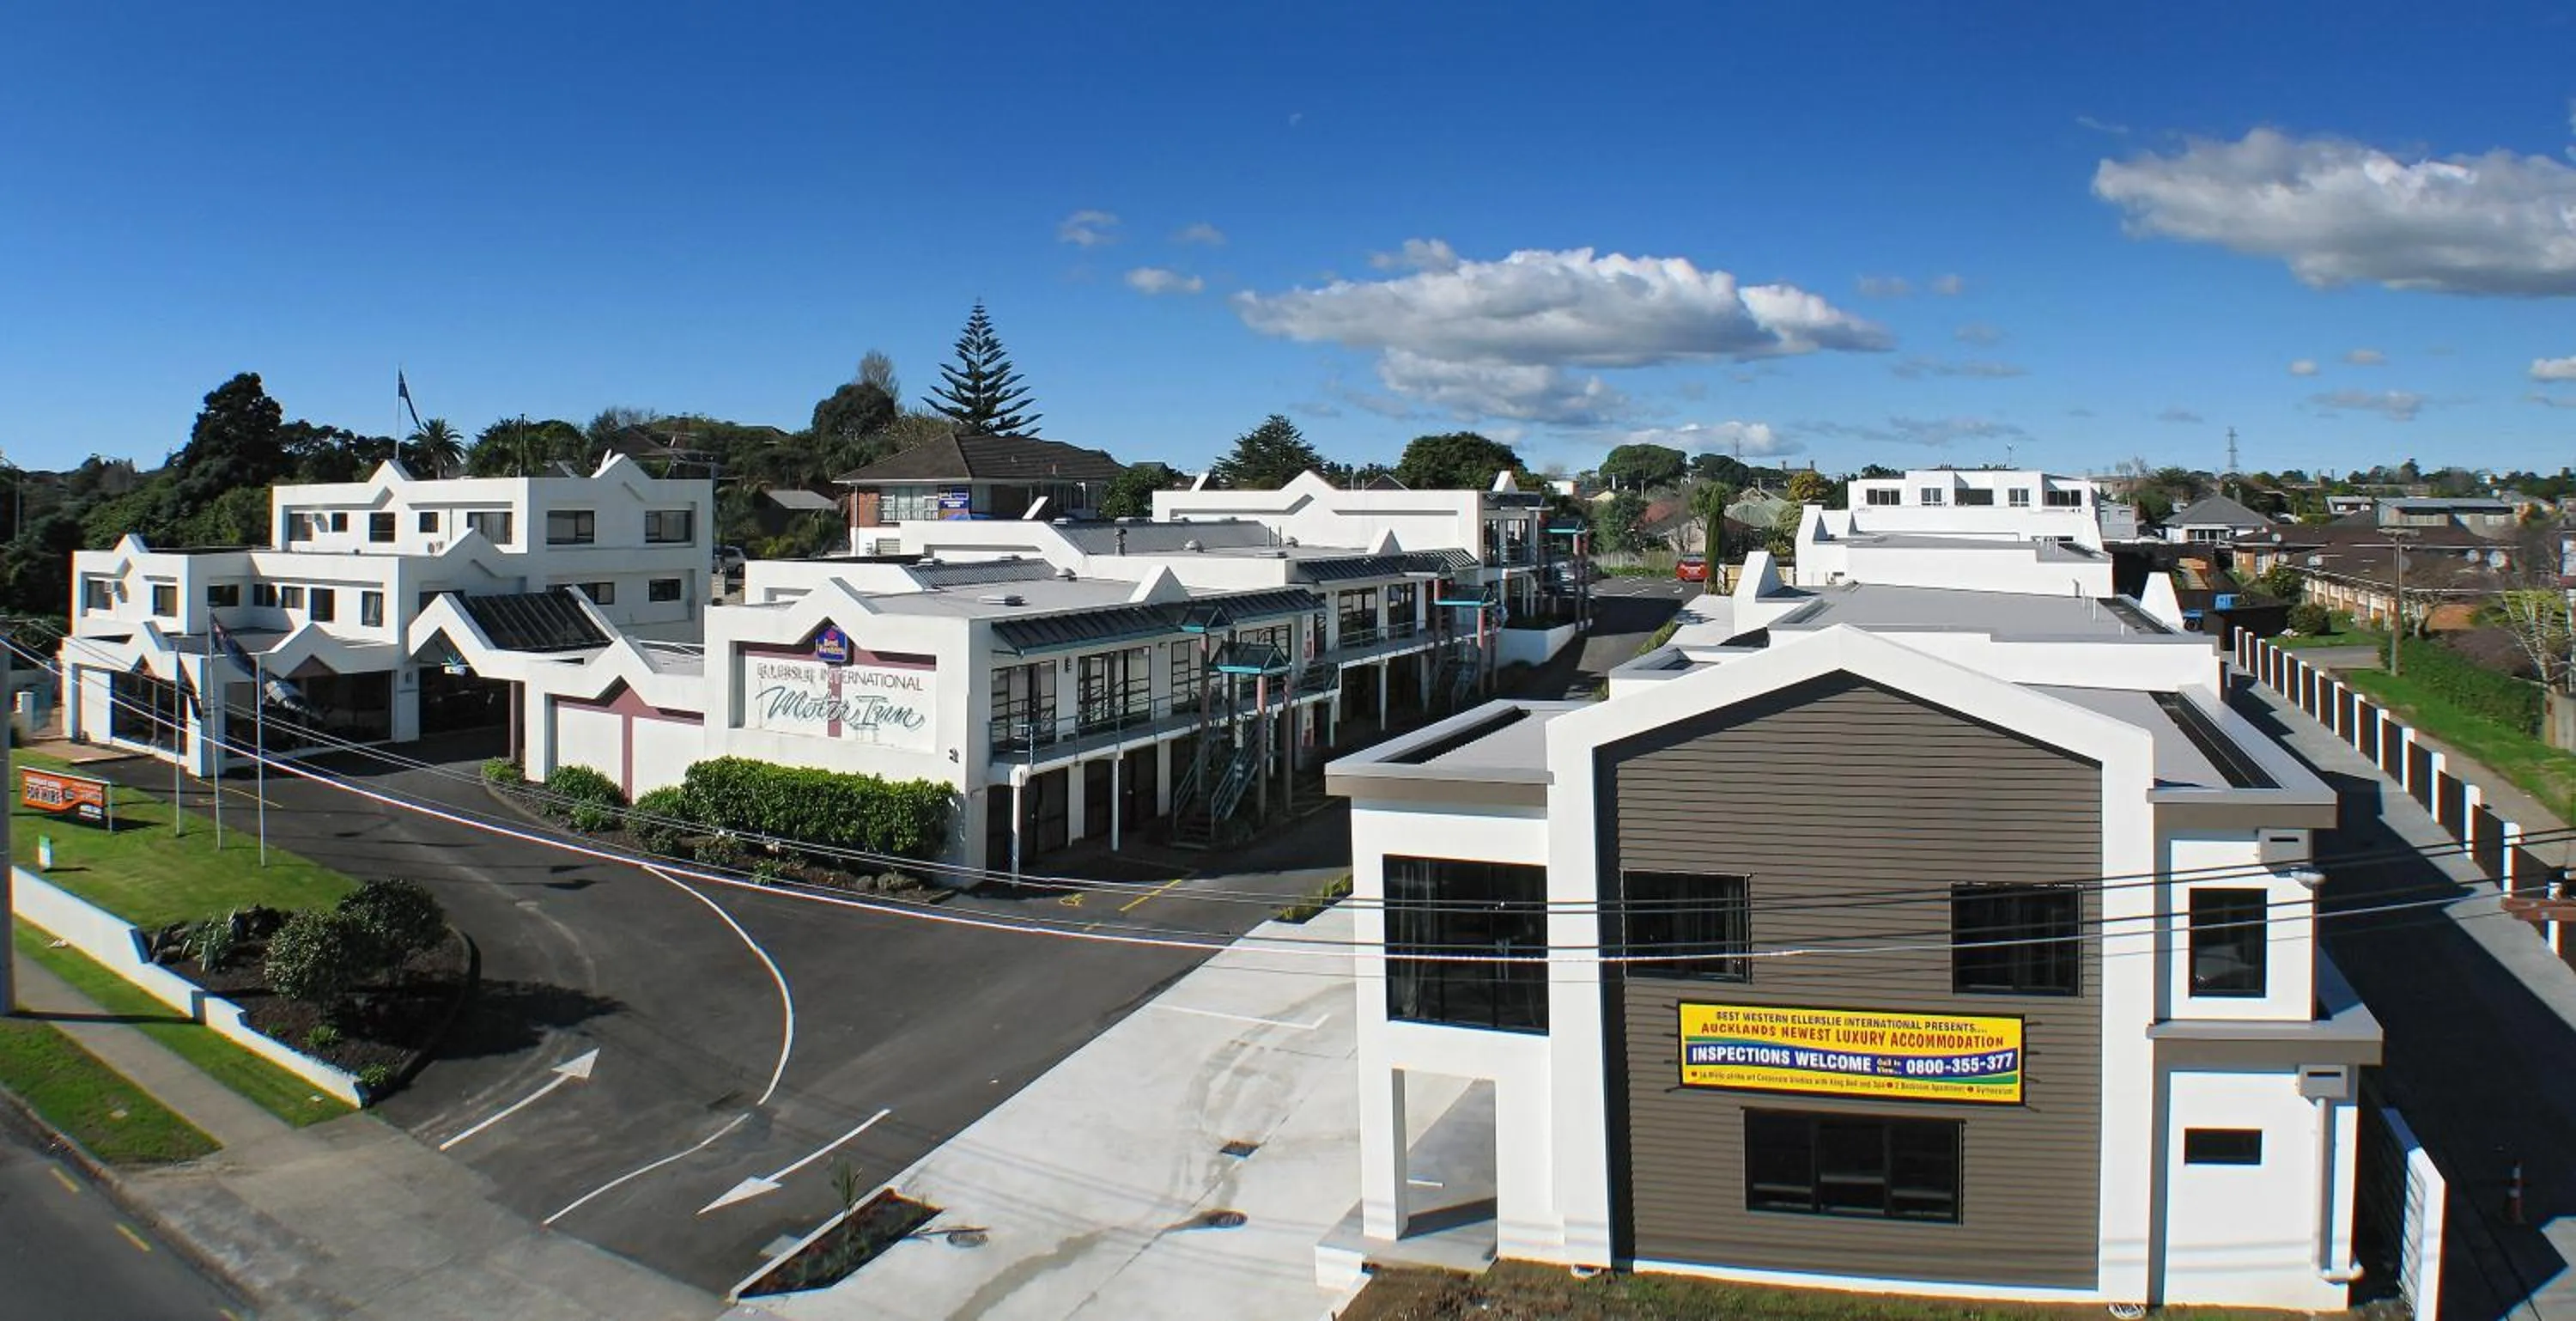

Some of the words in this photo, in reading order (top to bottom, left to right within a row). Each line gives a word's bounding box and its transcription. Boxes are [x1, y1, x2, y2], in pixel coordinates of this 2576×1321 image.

[756, 685, 860, 722] Motor
[849, 695, 926, 730] Inn
[1716, 1011, 1740, 1021] BEST
[1743, 1013, 1789, 1023] WESTERN
[1791, 1014, 1842, 1026] ELLERSLIE
[1844, 1017, 1922, 1030] INTERNATIONAL
[1701, 1023, 1776, 1037] AUCKLANDS
[1782, 1027, 1831, 1042] NEWEST
[1837, 1029, 1886, 1046] LUXURY
[1890, 1032, 2004, 1049] ACCOMMODATION
[1692, 1045, 1790, 1065] INSPECTIONS
[1795, 1050, 1871, 1072] WELCOME
[1906, 1051, 2014, 1074] 0800-355-377
